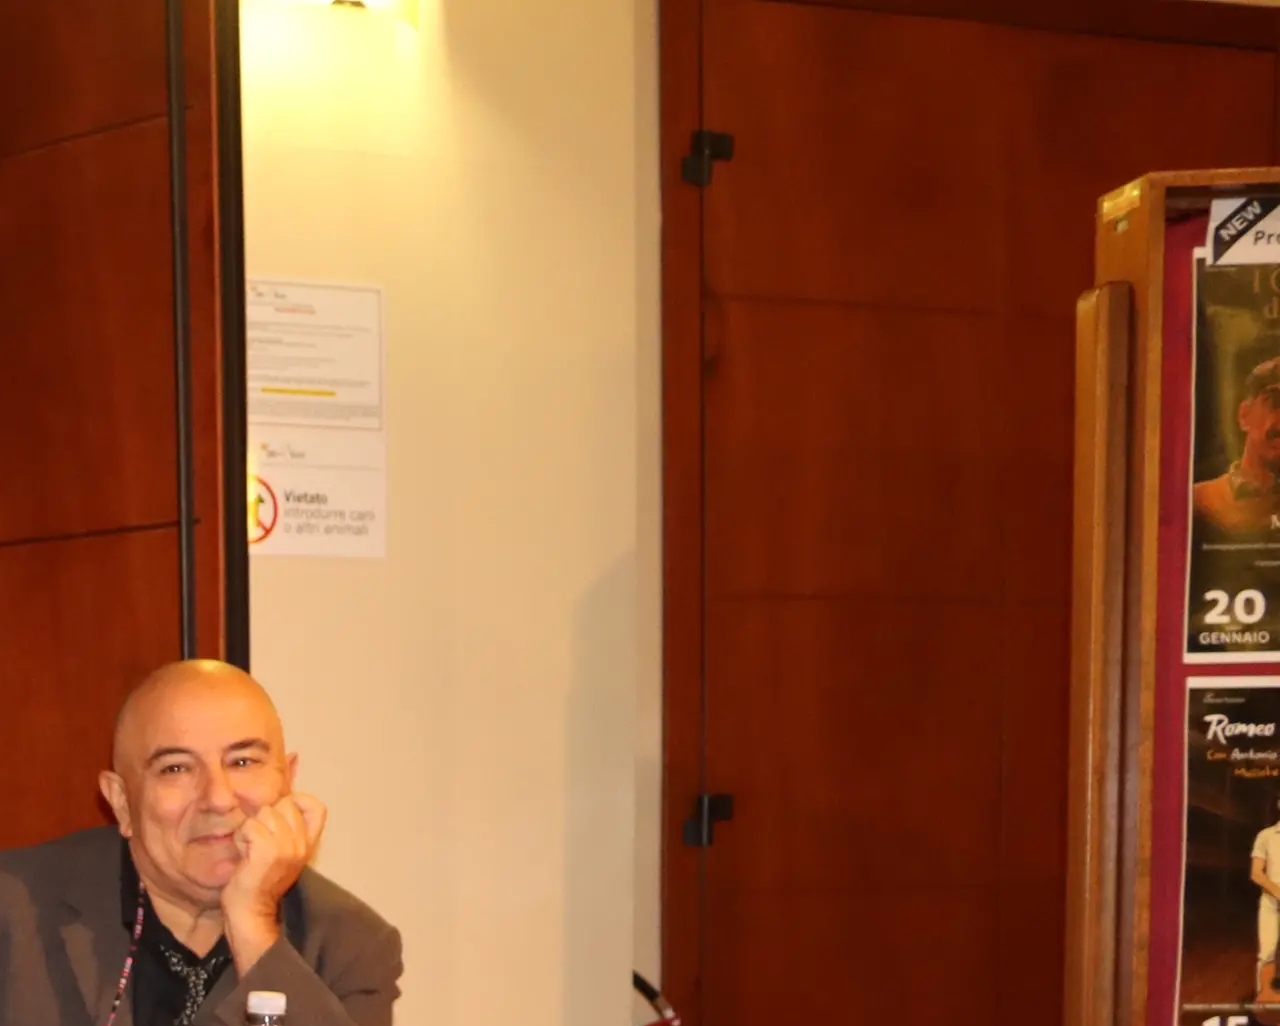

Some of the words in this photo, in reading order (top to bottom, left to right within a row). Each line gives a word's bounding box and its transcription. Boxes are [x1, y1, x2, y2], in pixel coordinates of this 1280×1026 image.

[1219, 200, 1262, 241] NEW
[284, 489, 328, 505] Vietato
[1204, 589, 1266, 624] 20
[1199, 630, 1270, 645] GENNAIO
[1203, 713, 1276, 745] Romeo
